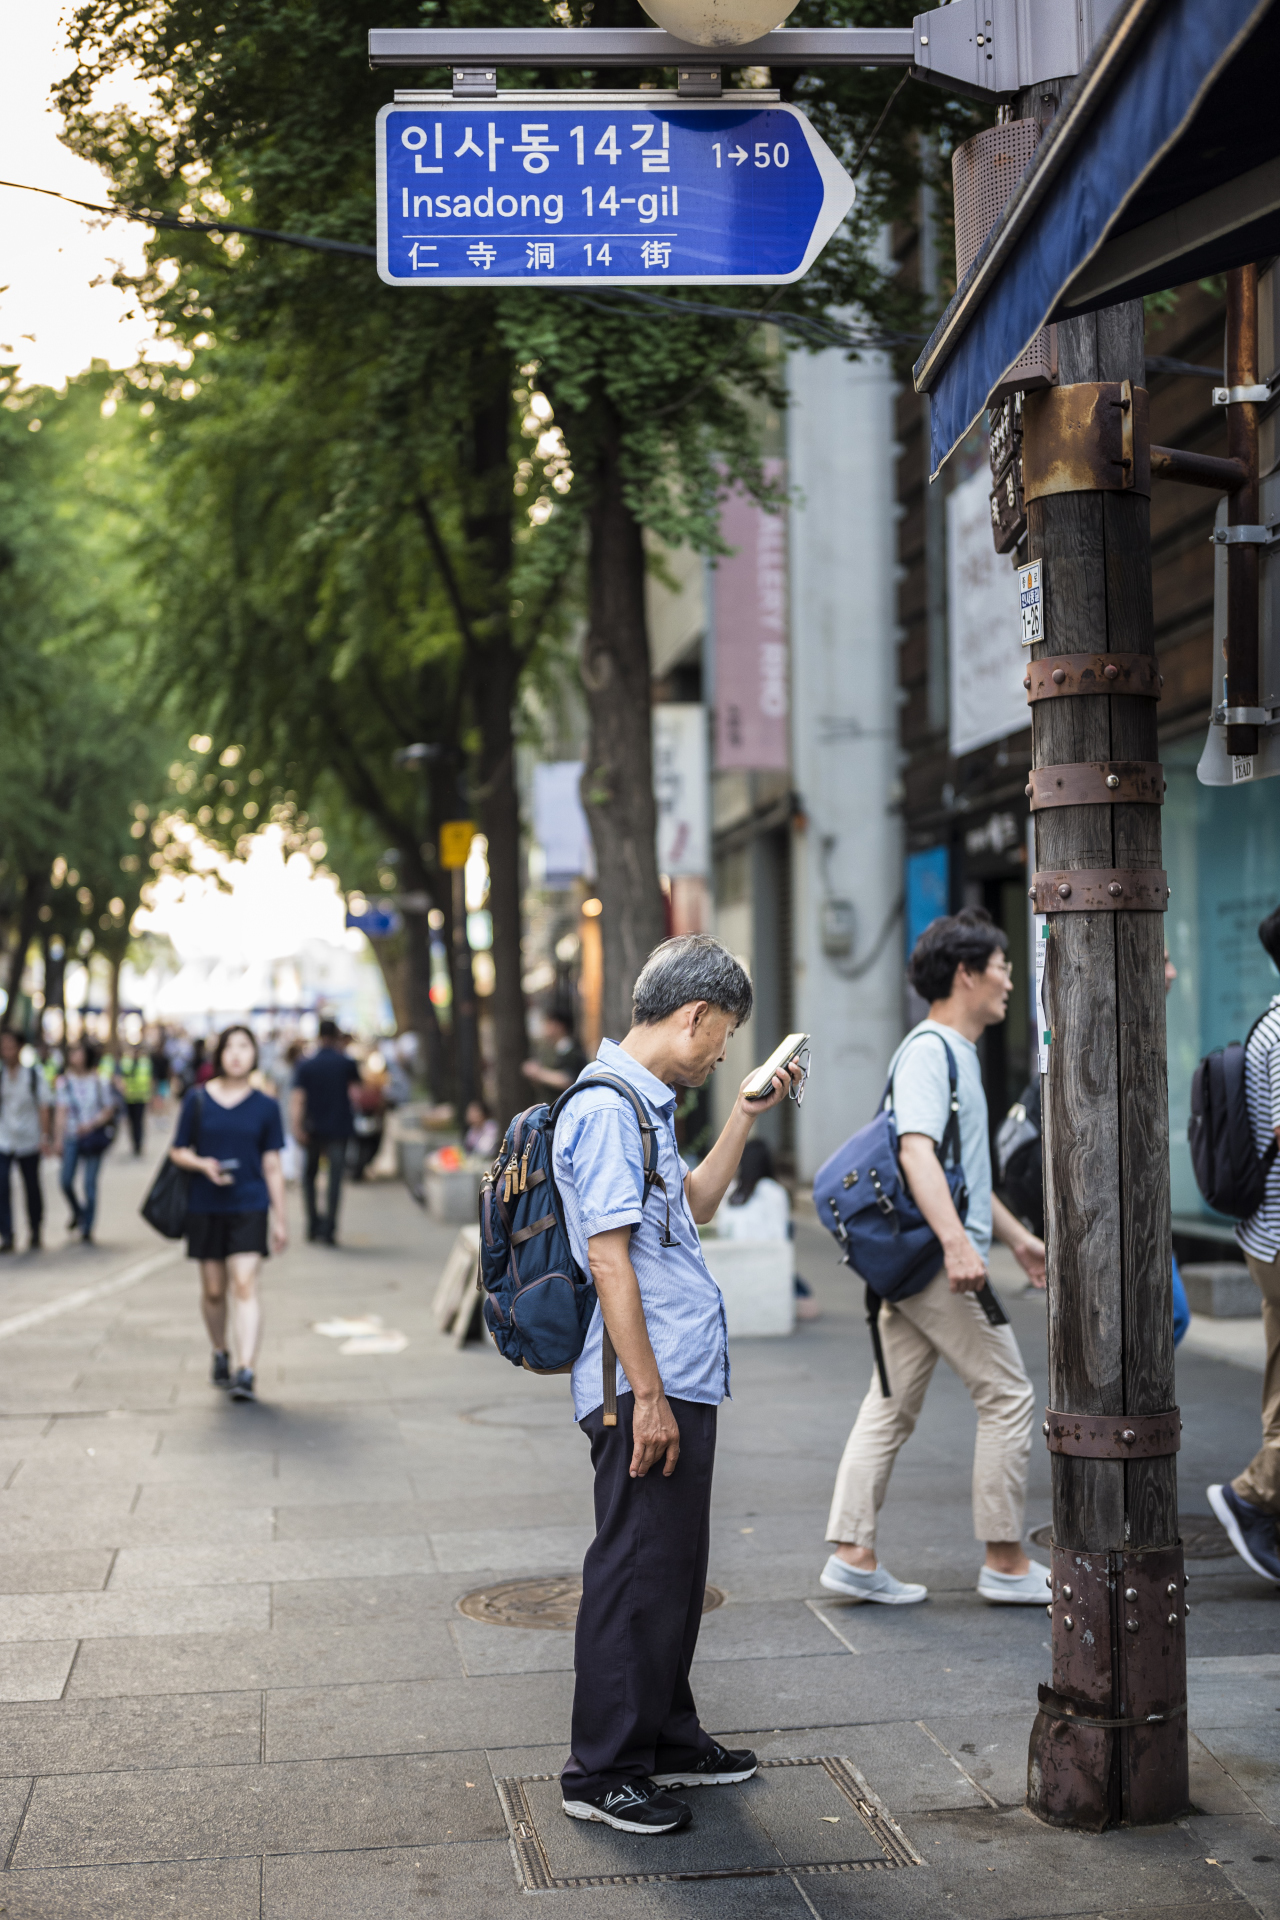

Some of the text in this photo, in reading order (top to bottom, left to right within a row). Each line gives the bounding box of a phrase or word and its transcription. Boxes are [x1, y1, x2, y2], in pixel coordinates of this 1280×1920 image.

[401, 121, 671, 174] 인사동14길
[754, 142, 790, 169] 50
[402, 185, 679, 224] Insadong 14-gil
[757, 510, 786, 630] ALLERY
[1022, 604, 1040, 638] 1-26
